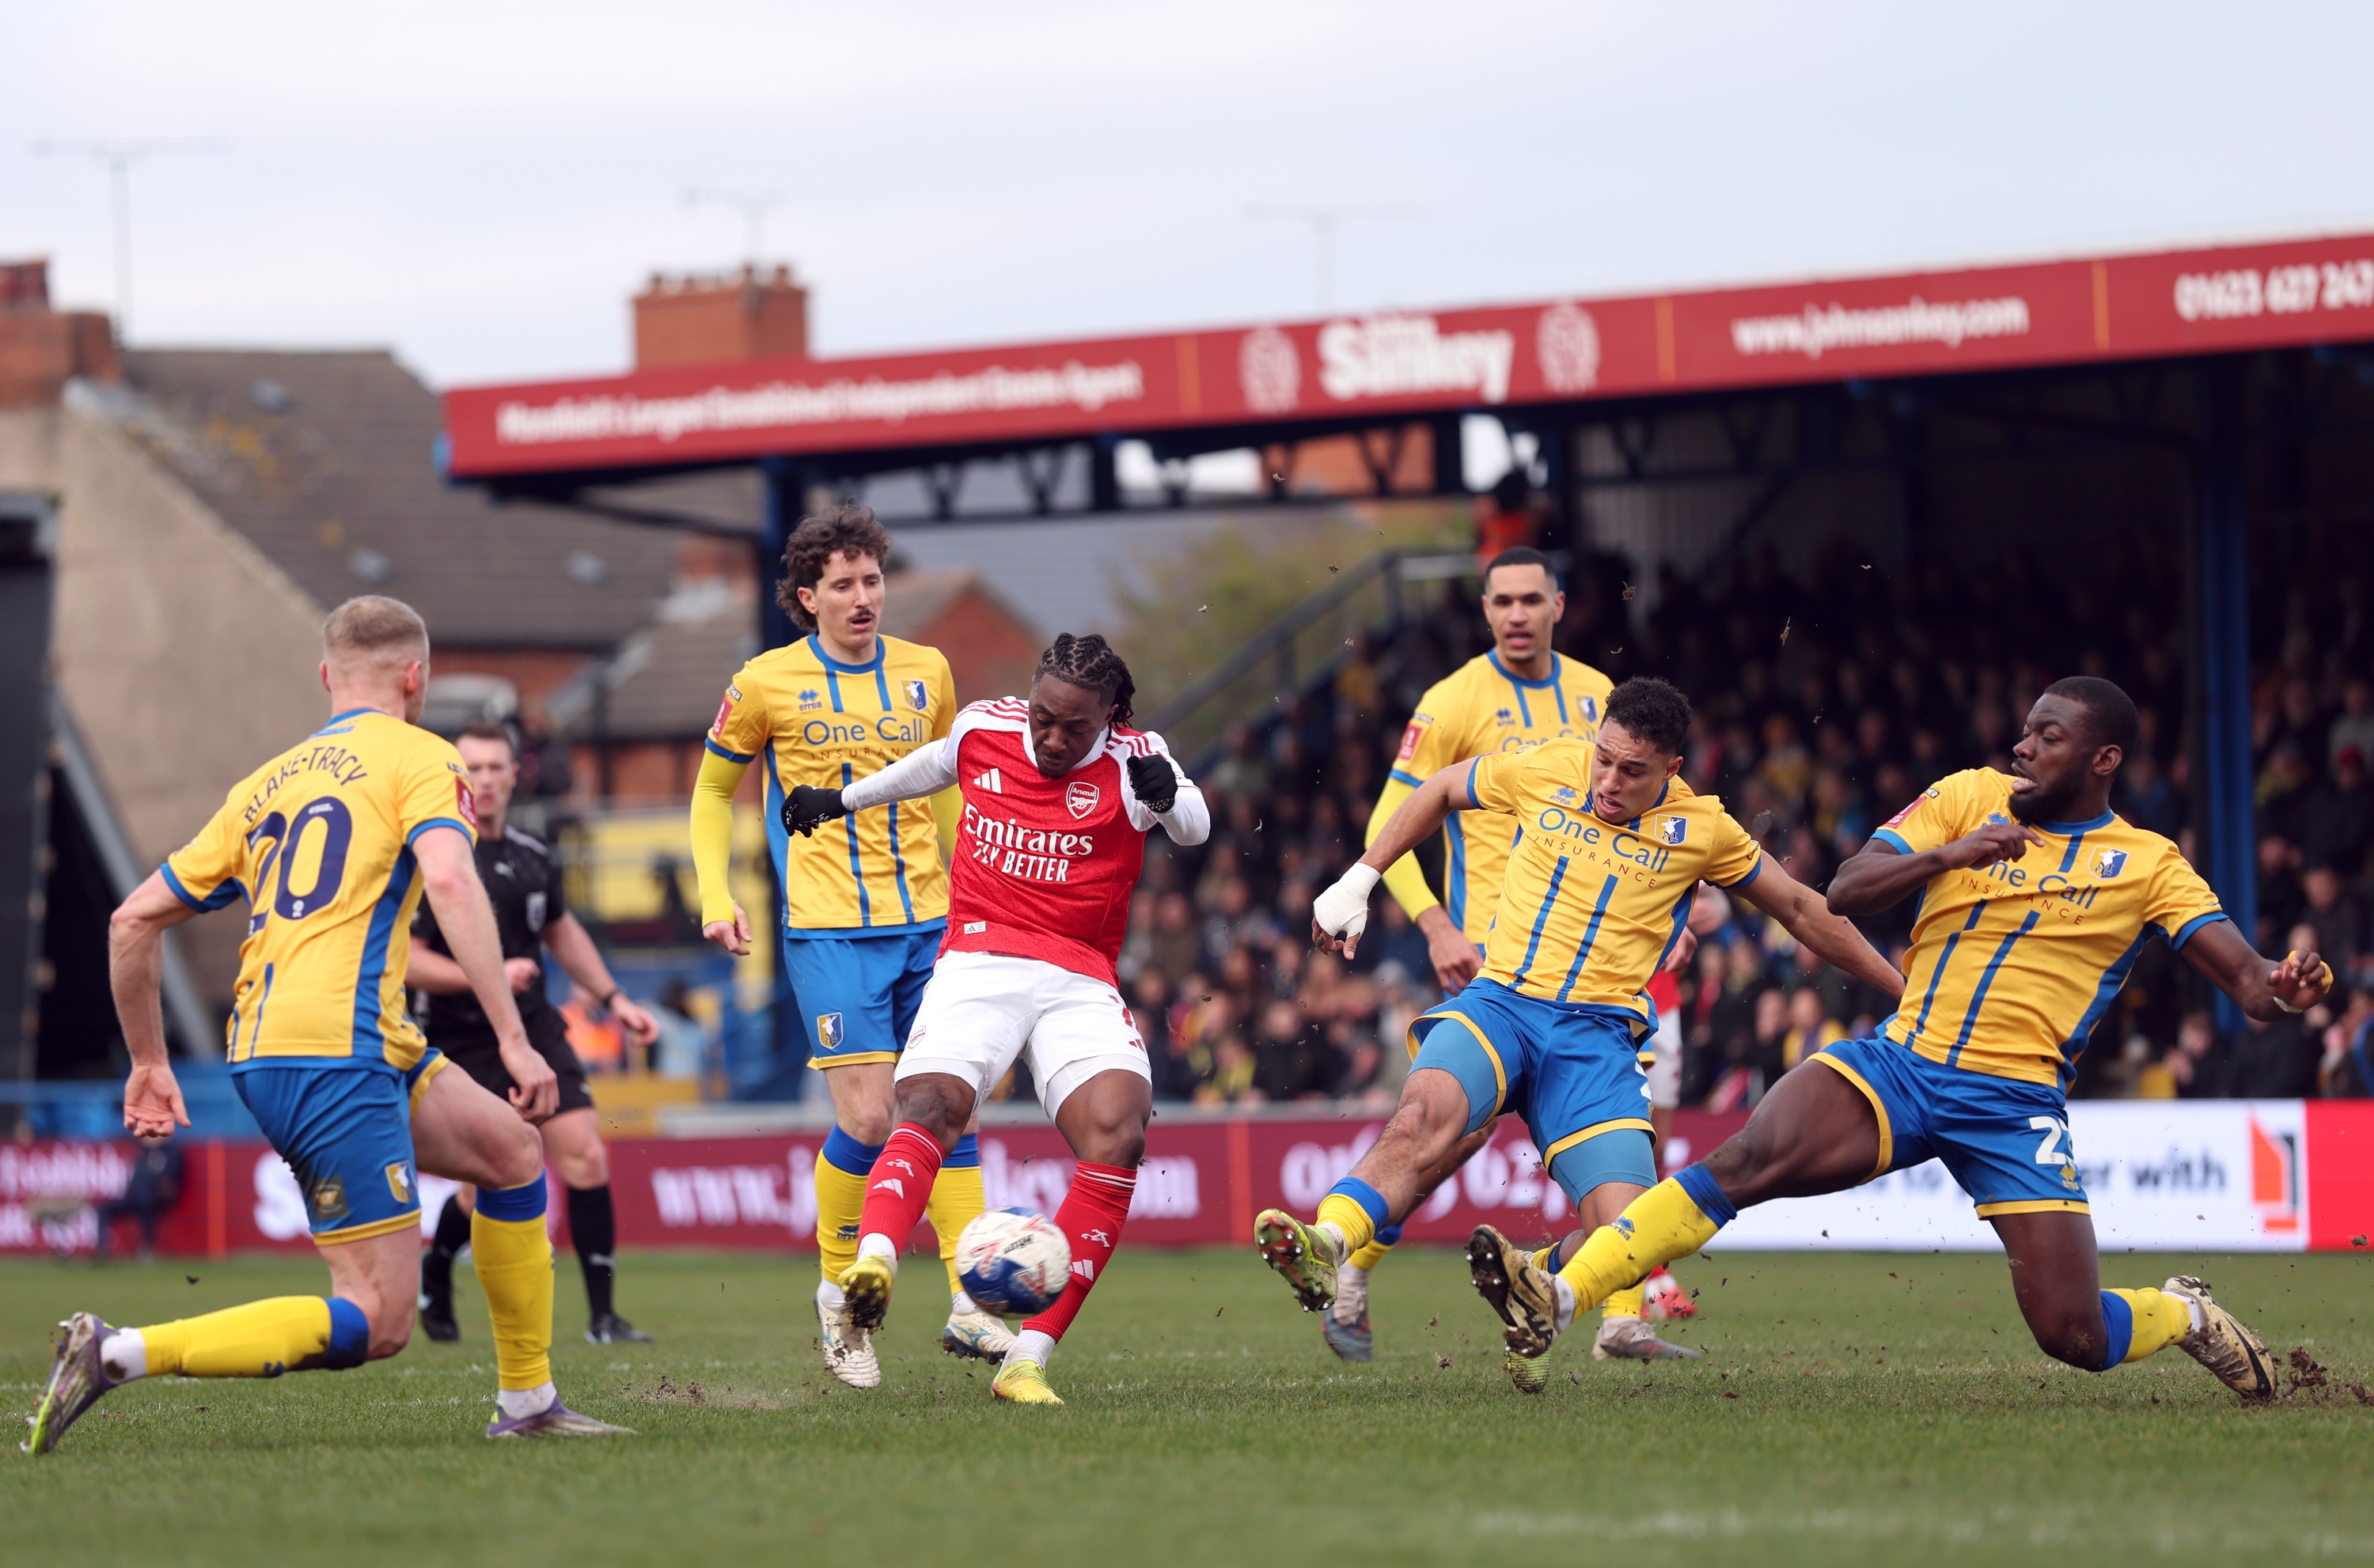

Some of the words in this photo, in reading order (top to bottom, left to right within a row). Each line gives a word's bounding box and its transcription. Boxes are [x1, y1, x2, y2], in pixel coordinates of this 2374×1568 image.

[804, 720, 865, 745] One
[877, 717, 923, 742] Call
[811, 748, 915, 760] INSURAN
[245, 746, 367, 823] BLAKE-TRACY
[1071, 786, 1095, 797] Arsenal
[965, 802, 1093, 856] Emirates
[1539, 808, 1600, 845] One
[1612, 832, 1669, 873] Call
[243, 796, 352, 938] 20
[1001, 850, 1069, 882] BETTER
[1534, 835, 1657, 888] INSURANCE
[1970, 860, 2026, 887] ne
[2038, 874, 2101, 910] Call
